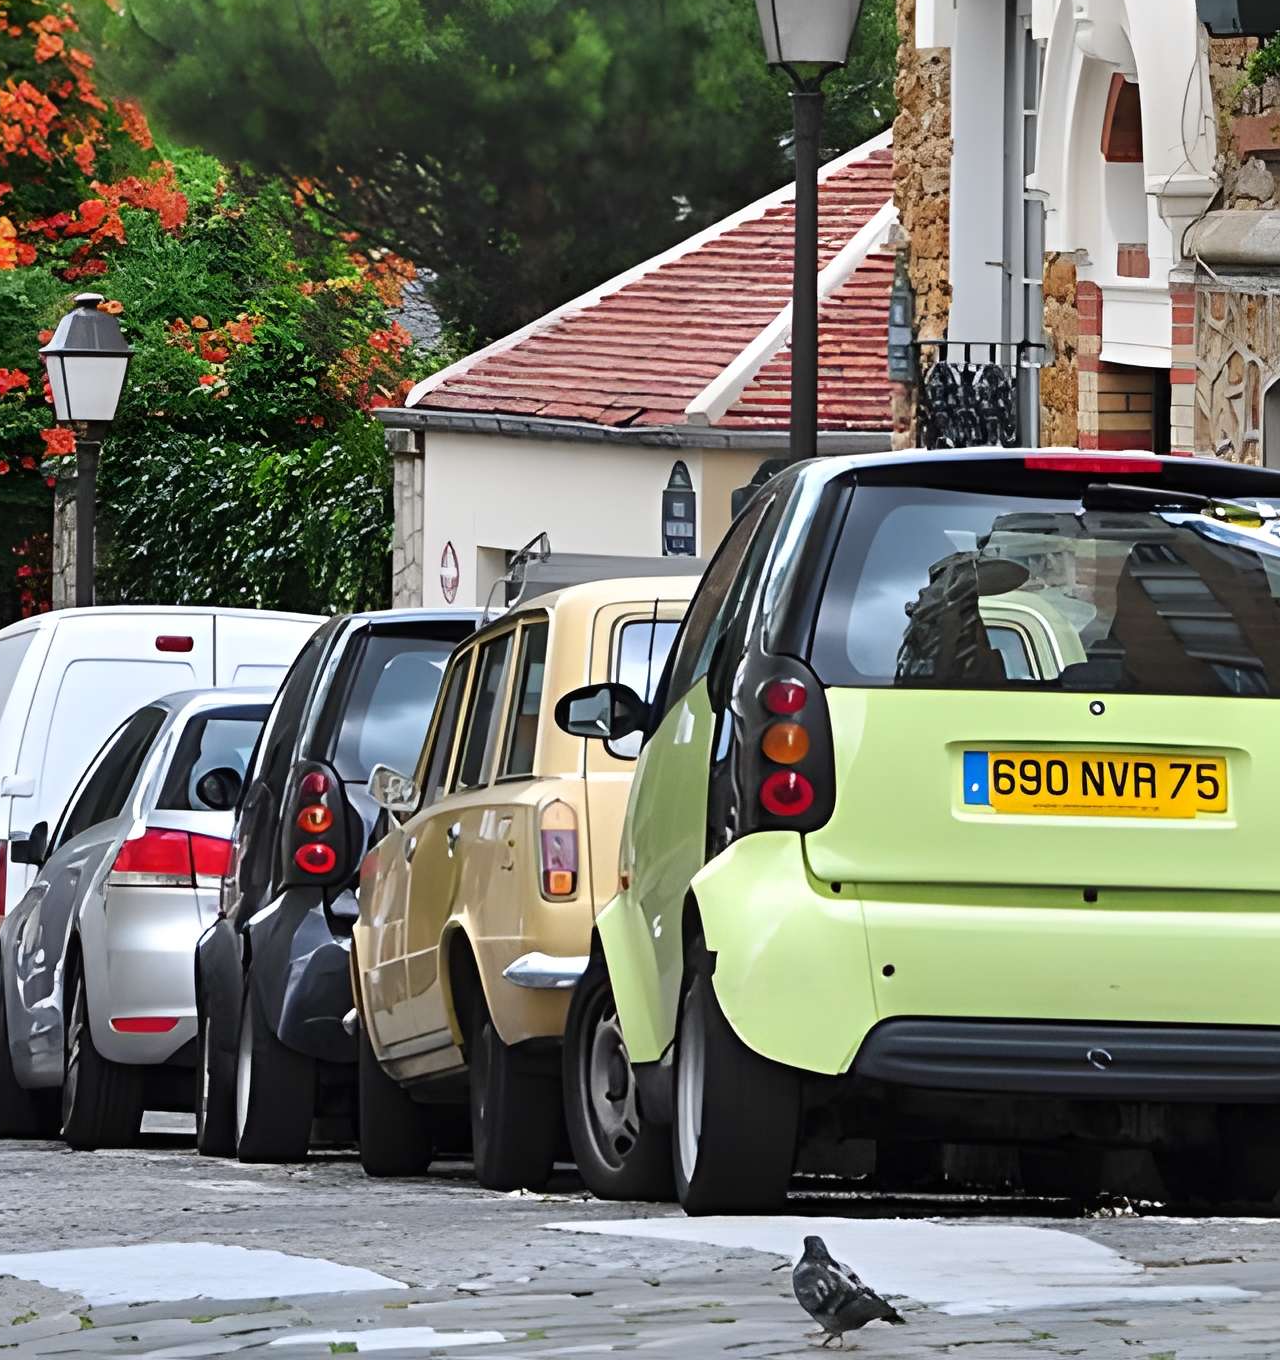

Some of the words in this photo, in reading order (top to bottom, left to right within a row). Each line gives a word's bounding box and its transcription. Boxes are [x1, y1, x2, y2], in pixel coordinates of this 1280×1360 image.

[992, 759, 1069, 796] 690
[1081, 761, 1156, 799] NVR
[1169, 763, 1220, 800] 75
